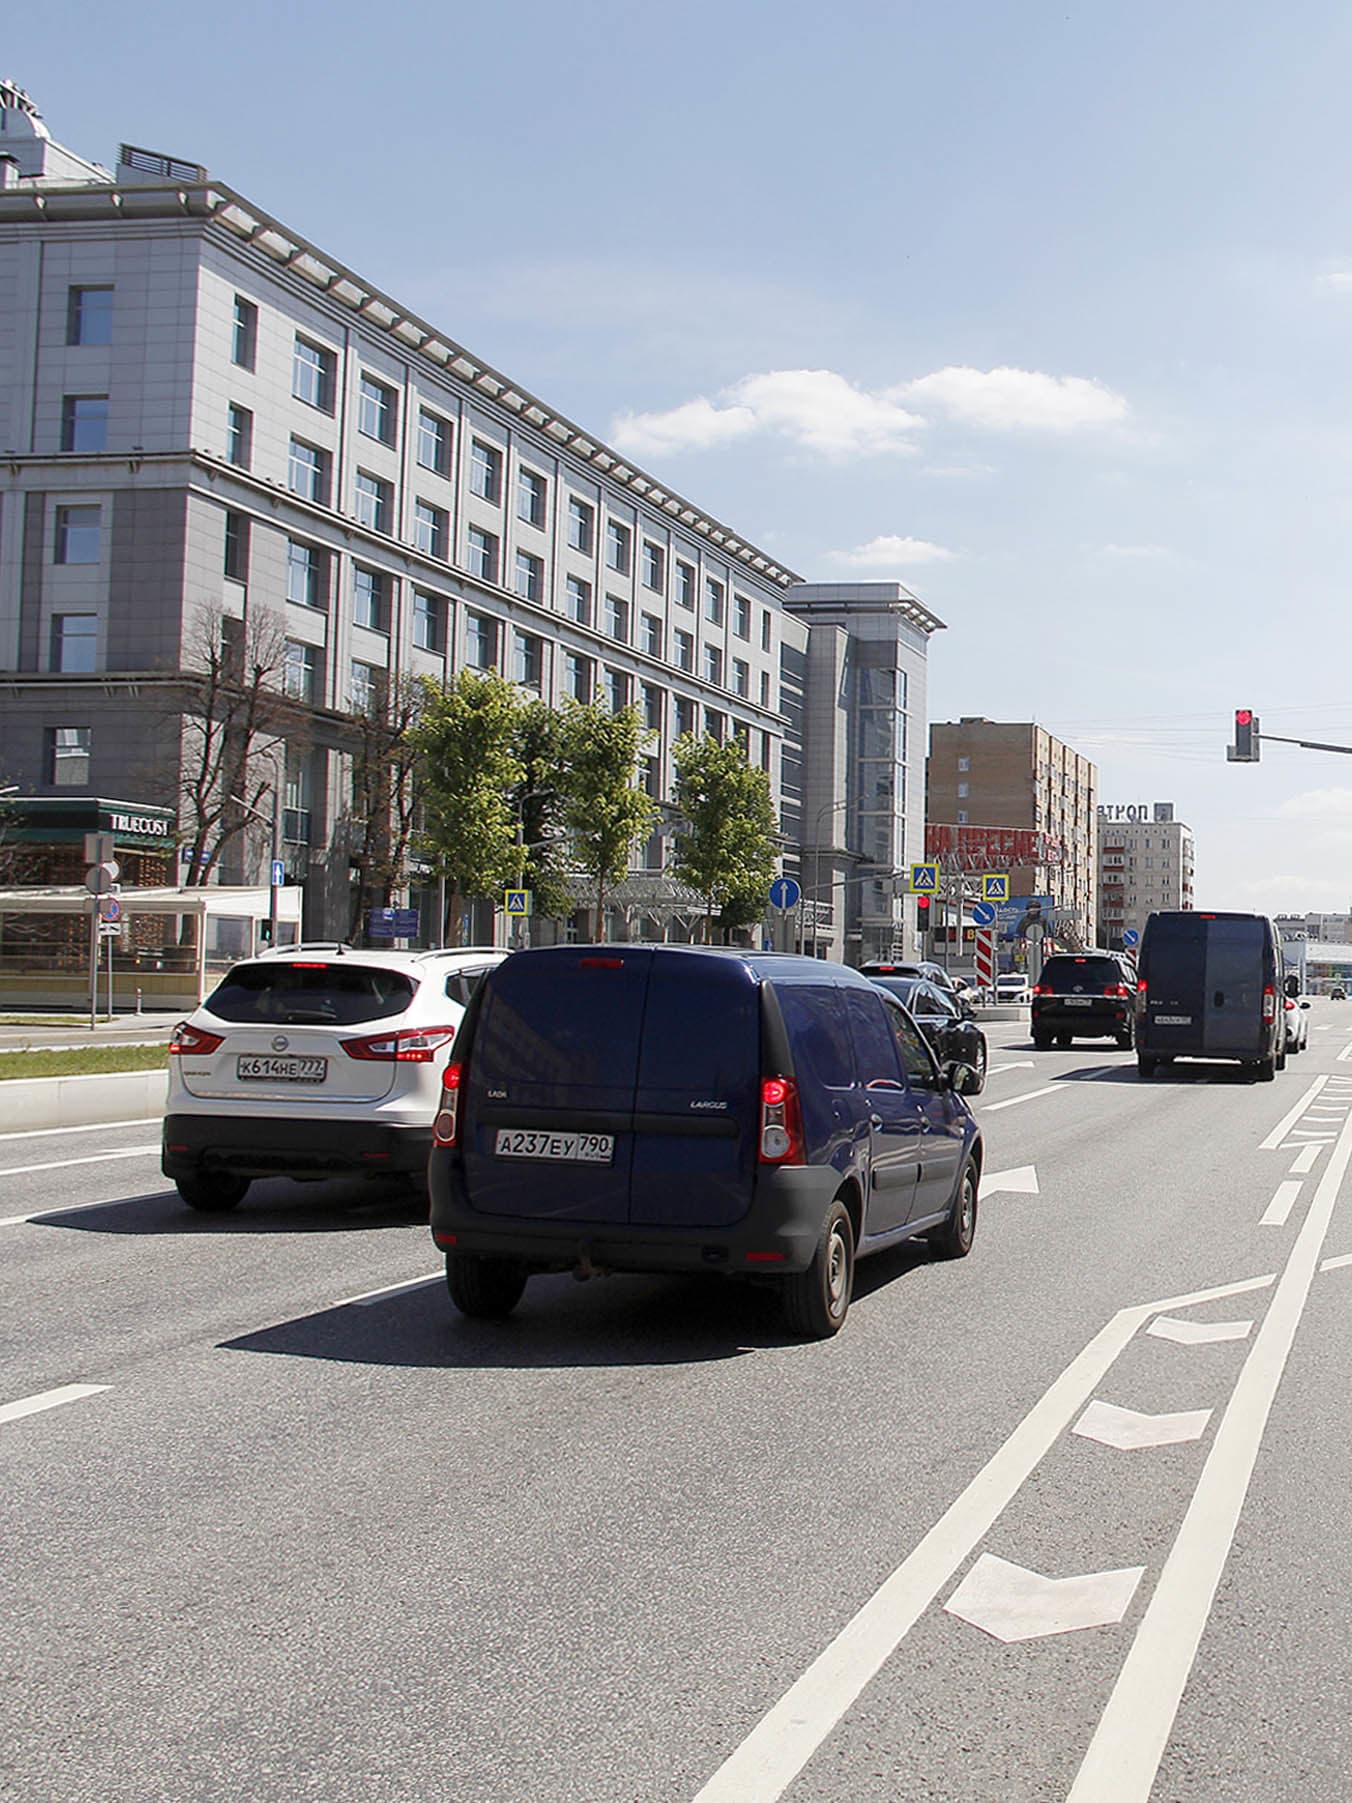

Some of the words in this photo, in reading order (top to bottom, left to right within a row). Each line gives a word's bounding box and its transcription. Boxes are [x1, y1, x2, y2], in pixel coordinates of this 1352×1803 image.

[110, 814, 167, 836] TRUECOST
[242, 1059, 297, 1076] К614НЕ
[500, 1133, 575, 1156] А237ЕУ
[580, 1136, 609, 1153] 790
